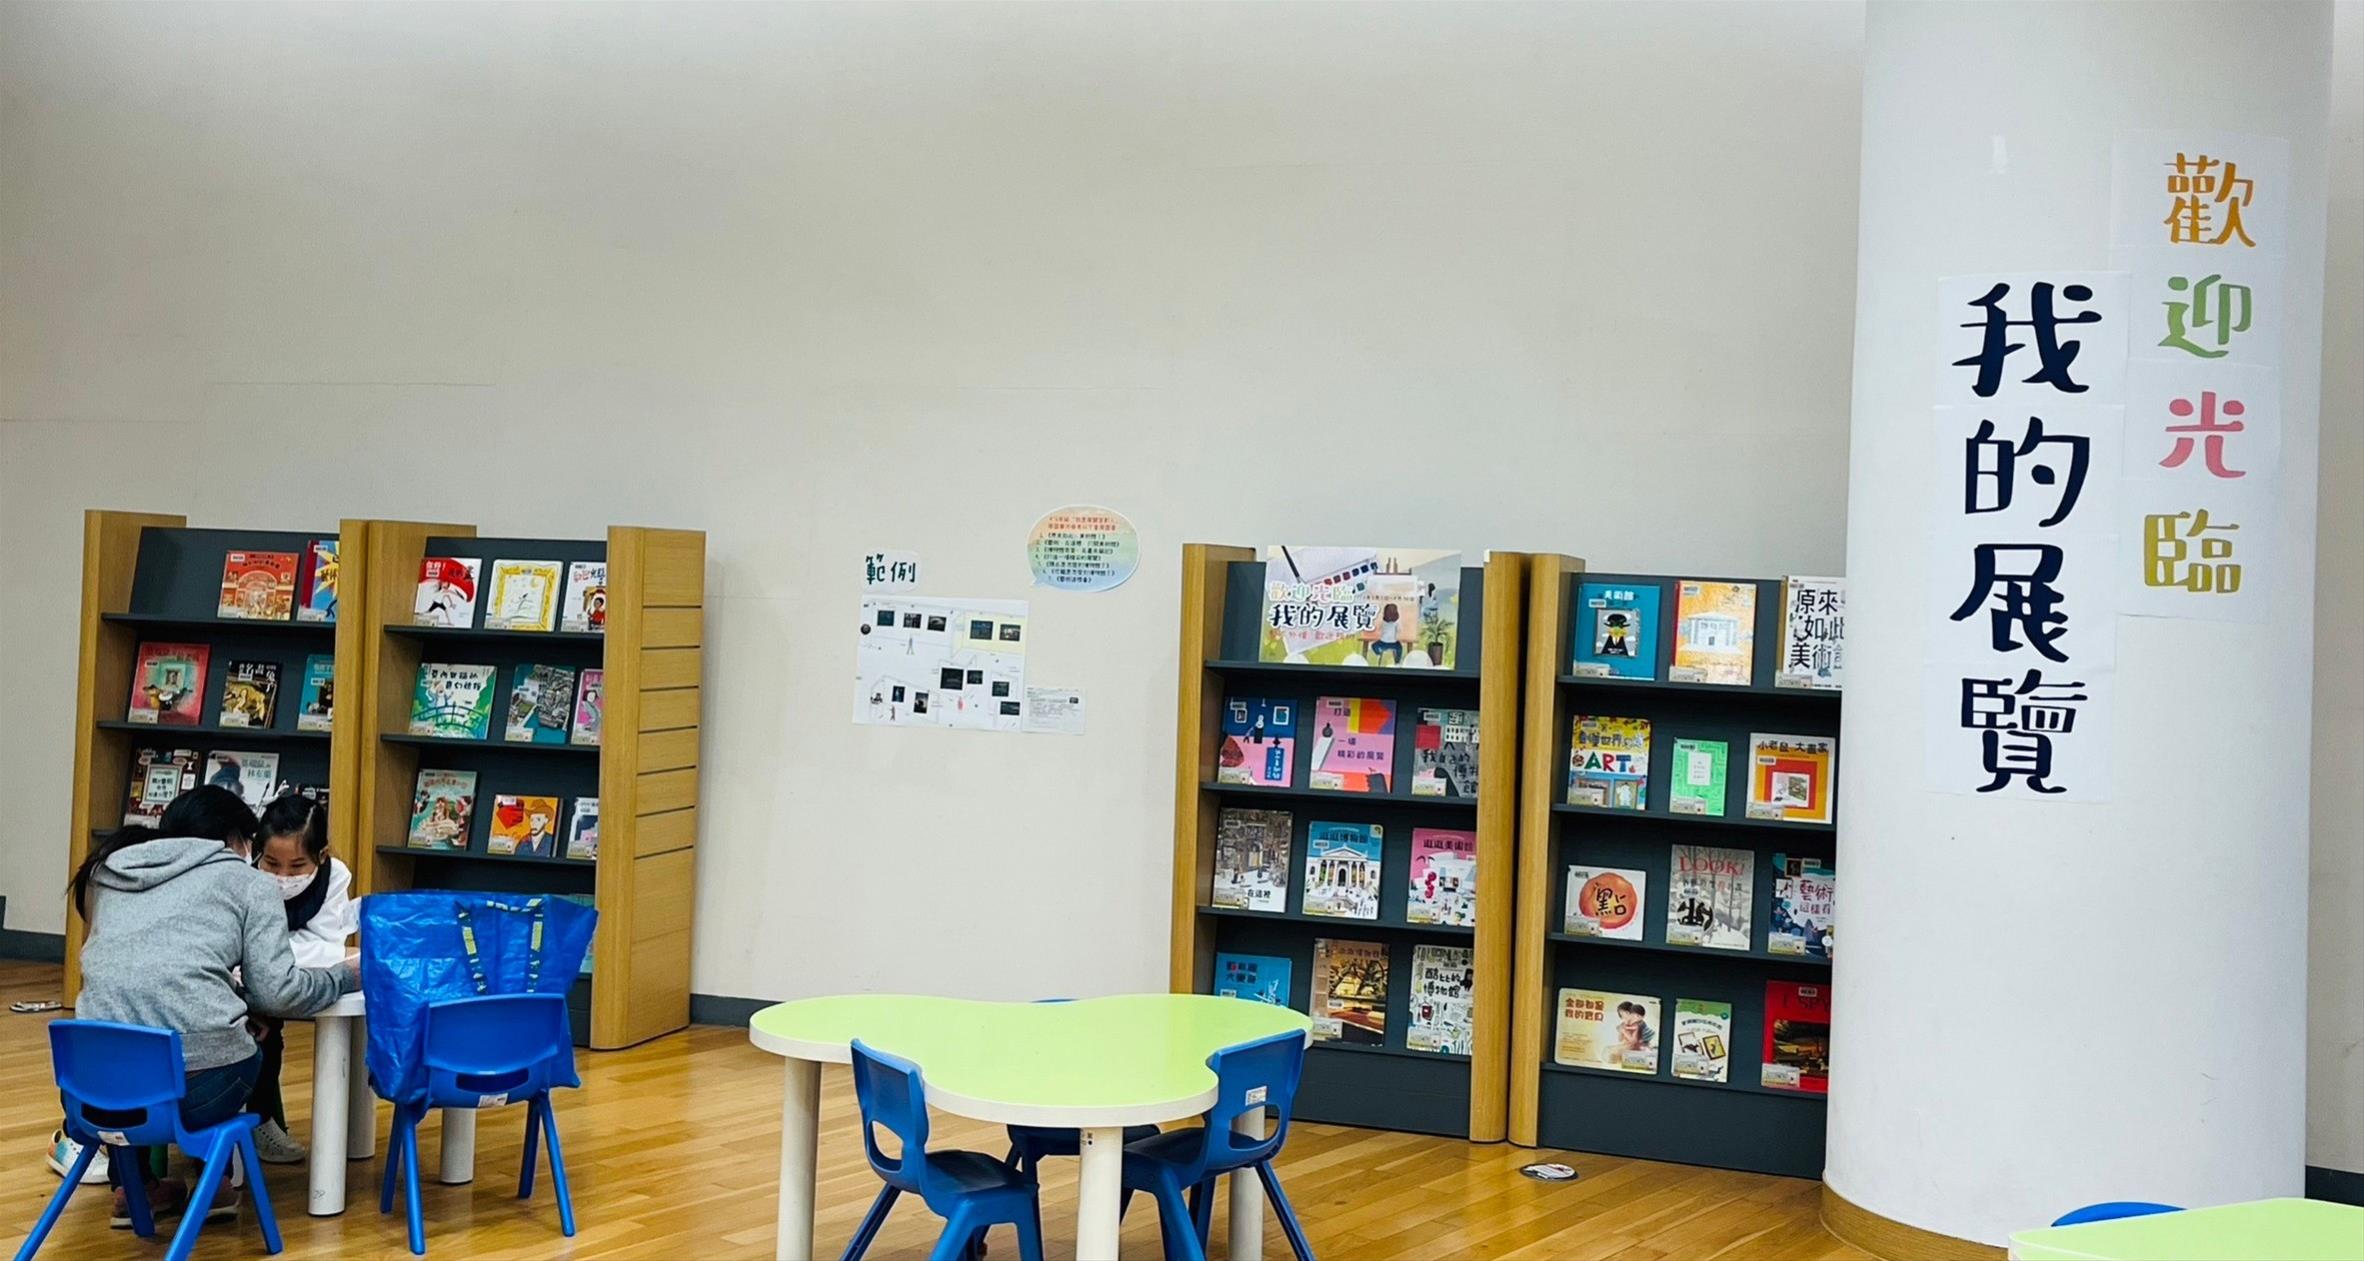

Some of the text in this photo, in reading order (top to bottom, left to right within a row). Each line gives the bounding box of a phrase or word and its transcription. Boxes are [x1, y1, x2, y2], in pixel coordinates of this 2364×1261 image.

[2144, 152, 2257, 594] 歡迎光臨
[1949, 281, 2103, 793] 我的展覽
[865, 553, 917, 585] 範例
[1269, 581, 1354, 603] 歡迎光臨
[1795, 589, 1839, 616] 原來
[1269, 603, 1379, 630] 我的展覽
[1793, 615, 1845, 641] 如此
[1584, 751, 1632, 773] ART
[1799, 879, 1834, 903] 藝術
